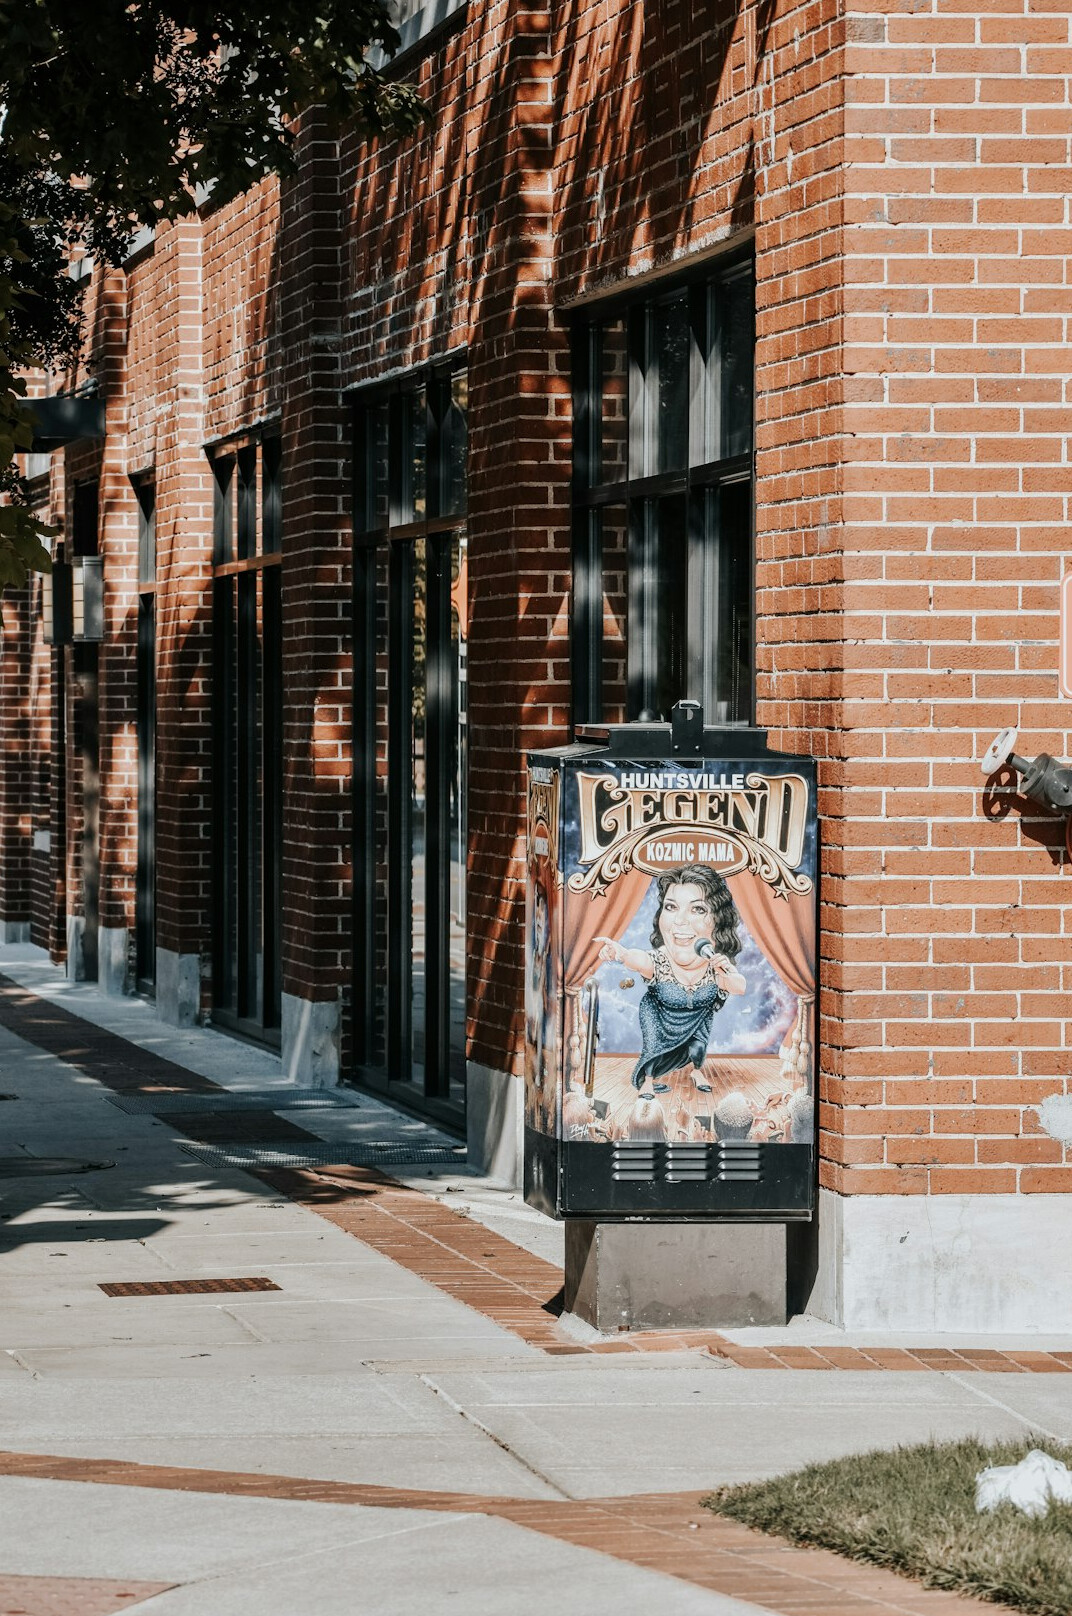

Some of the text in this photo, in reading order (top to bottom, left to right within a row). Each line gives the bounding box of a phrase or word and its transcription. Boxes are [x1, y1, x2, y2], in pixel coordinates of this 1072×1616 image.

[620, 772, 745, 790] HUNTSVILLE
[576, 771, 809, 870] LEGEND
[646, 842, 735, 862] KOZMIC MAMA
